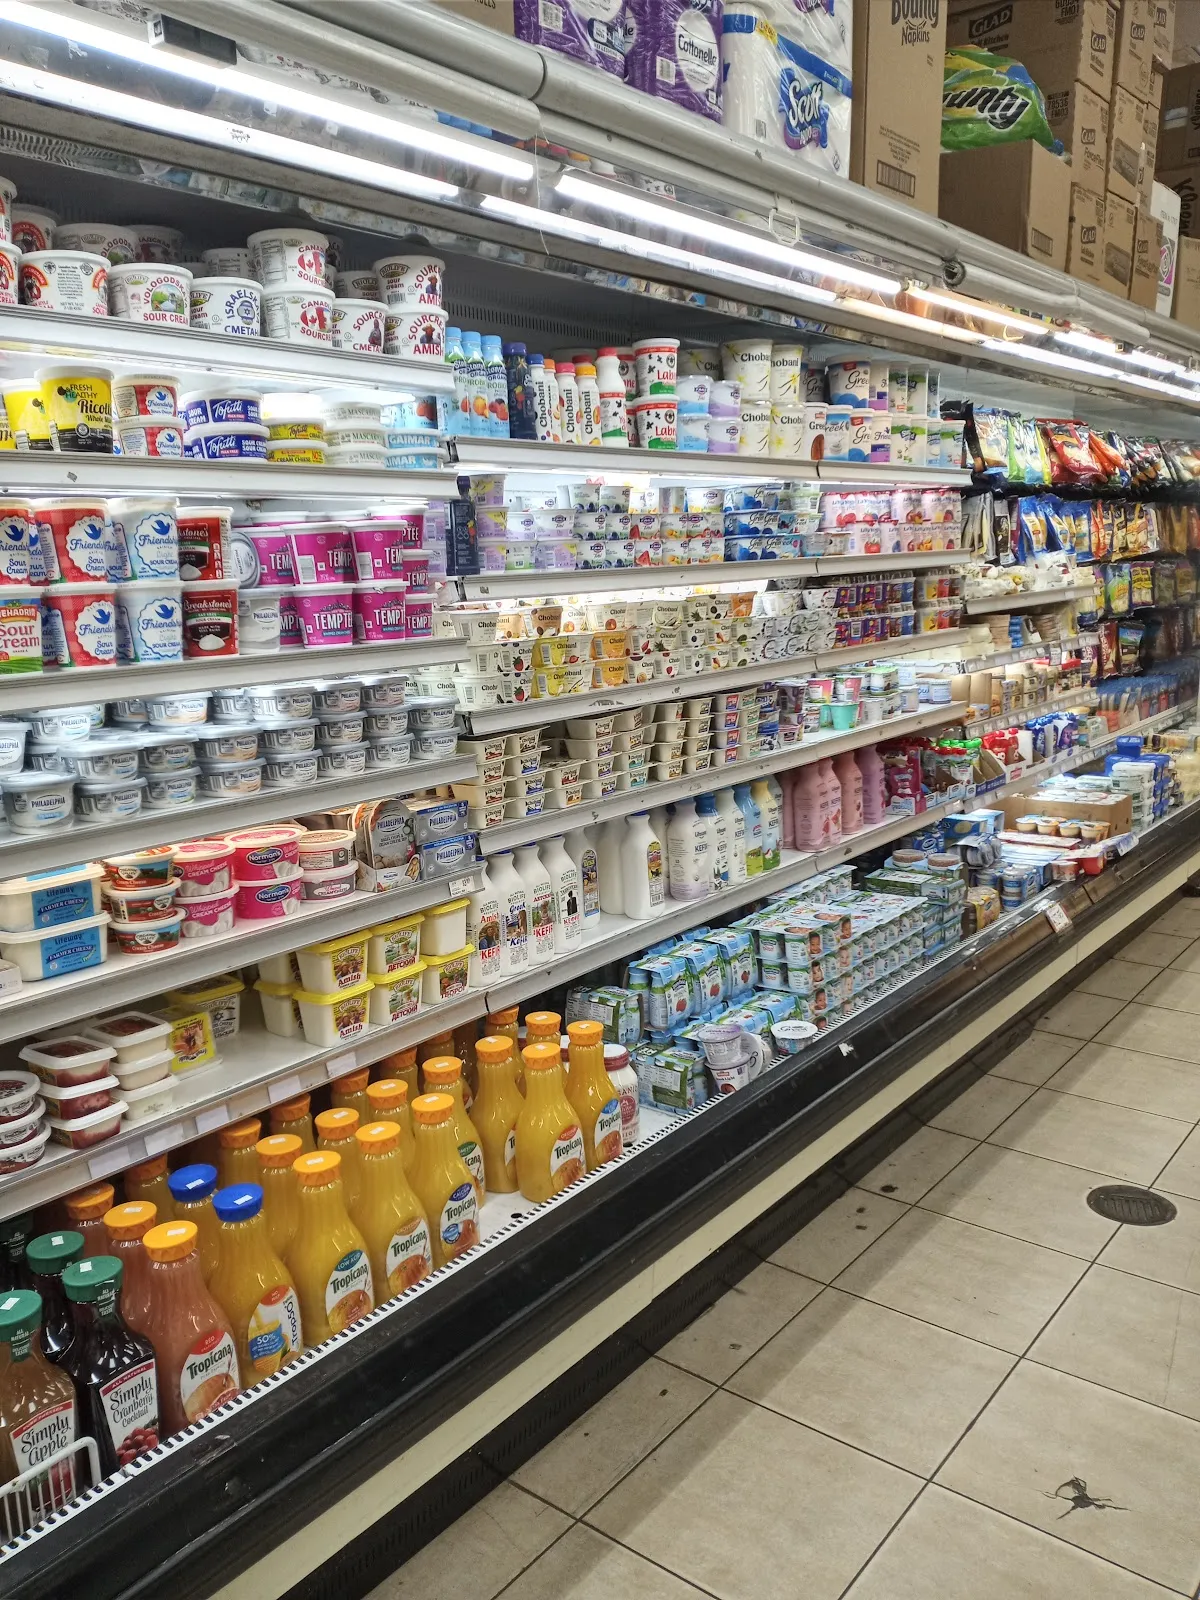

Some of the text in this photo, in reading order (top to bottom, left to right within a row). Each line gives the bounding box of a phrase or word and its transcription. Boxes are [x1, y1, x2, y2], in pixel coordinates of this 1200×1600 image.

[971, 9, 1011, 37] GLAD
[901, 24, 930, 46] Napkins
[678, 34, 718, 66] Cottonelle
[788, 80, 824, 128] Scott
[143, 311, 167, 322] SOUR
[65, 391, 98, 399] HEALTHY
[213, 400, 244, 420] Tofutti
[535, 381, 547, 427] Chobani
[566, 388, 575, 433] Chobani
[188, 408, 202, 417] SOUR
[585, 390, 594, 435] Chobani
[207, 436, 236, 456] Tofutti
[9, 559, 27, 567] Sour
[31, 796, 65, 808] PHILADELPHIA
[377, 817, 405, 829] PHILADELPHIA
[429, 815, 457, 827] PHILADELPHIA
[249, 851, 281, 862] Norman's
[436, 847, 464, 861] PHILADELPHIA
[185, 861, 215, 872] Whipped
[187, 861, 228, 877] CREAM CHEESE
[258, 888, 290, 899] Norman's
[41, 901, 64, 912] FARMER
[190, 901, 219, 913] Whipped
[192, 902, 232, 919] CREAM CHEESE
[55, 933, 82, 944] lifeway
[50, 950, 72, 961] FARMER
[337, 973, 362, 987] Amish
[339, 1023, 364, 1038] Amish
[554, 1137, 582, 1159] Tropicana
[445, 1197, 477, 1221] Tropicana
[391, 1230, 427, 1257] Tropicana
[337, 1258, 350, 1270] LOW
[330, 1264, 369, 1294] Tropicana
[204, 1335, 216, 1346] RED
[256, 1333, 276, 1345] 50%
[187, 1343, 233, 1380] Tropicana
[110, 1376, 153, 1411] Simply
[112, 1395, 154, 1423] Cranberry
[121, 1409, 149, 1428] Cocktail
[21, 1415, 72, 1453] Simply
